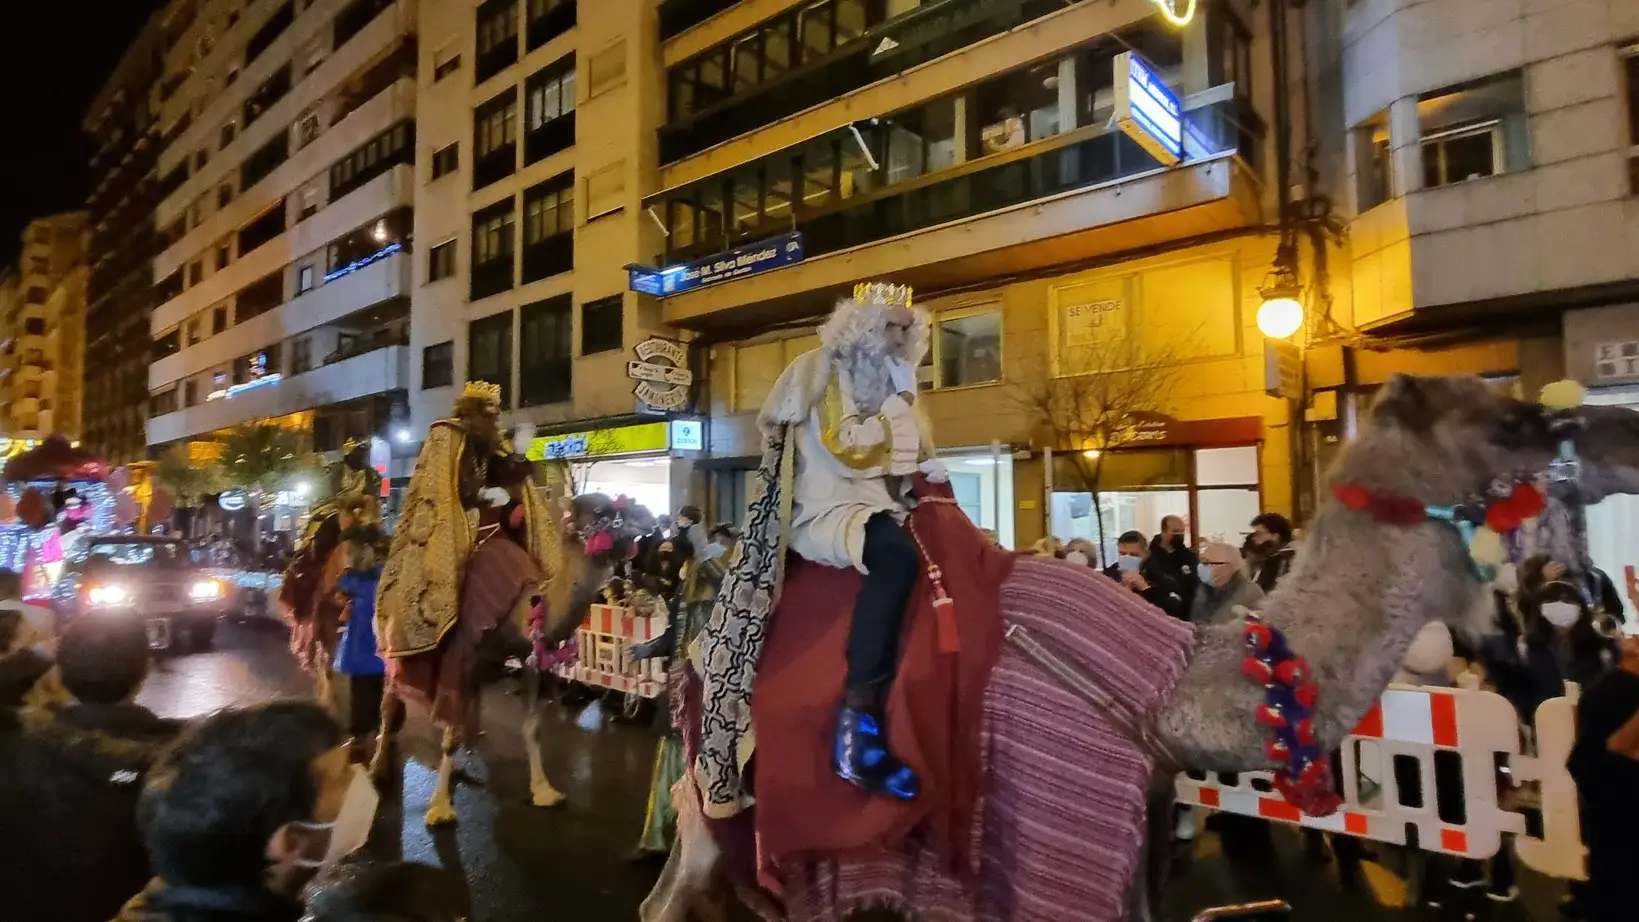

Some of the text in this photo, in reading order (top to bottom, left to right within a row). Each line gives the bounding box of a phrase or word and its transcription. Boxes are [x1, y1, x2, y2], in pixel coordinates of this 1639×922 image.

[713, 259, 736, 273] Silva
[1069, 300, 1122, 318] SE VENDE
[676, 437, 698, 445] ZURICH
